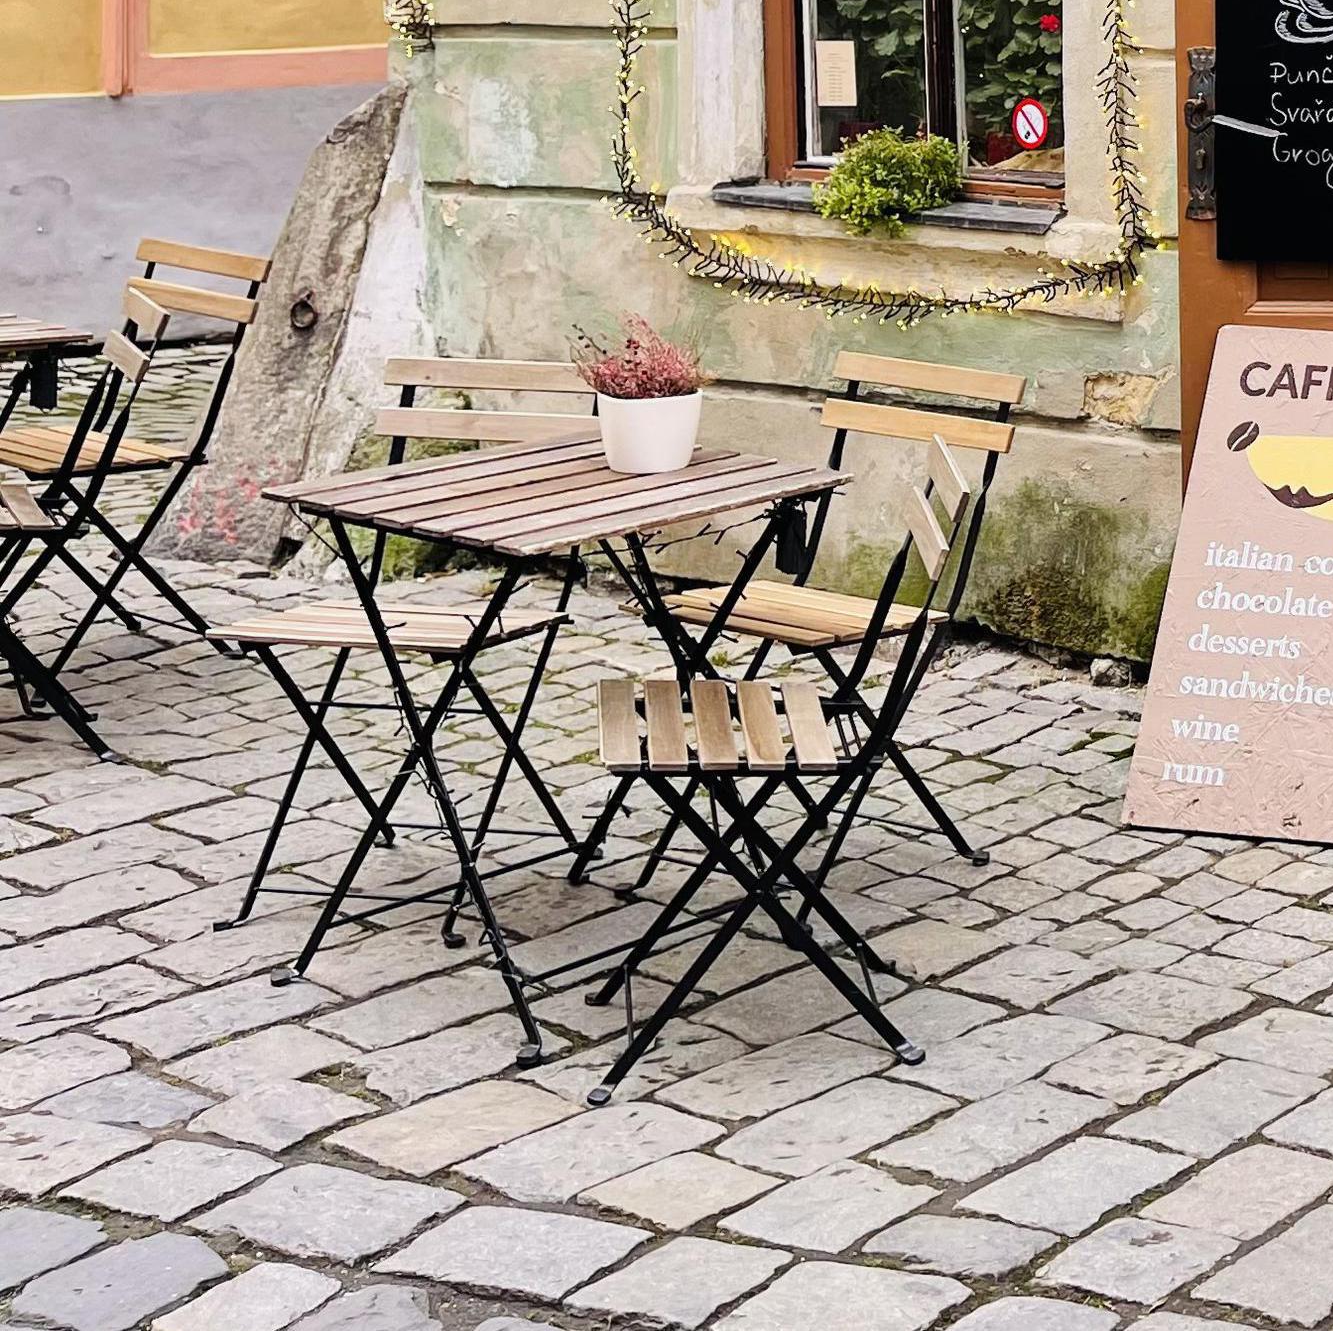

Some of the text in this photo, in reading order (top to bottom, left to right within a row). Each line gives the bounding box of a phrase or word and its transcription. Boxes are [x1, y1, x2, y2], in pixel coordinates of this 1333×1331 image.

[1204, 540, 1294, 572] italian
[1196, 581, 1333, 618] chocolate
[1188, 625, 1301, 660] desserts
[1171, 714, 1240, 743] wine
[1162, 760, 1226, 786] rum
